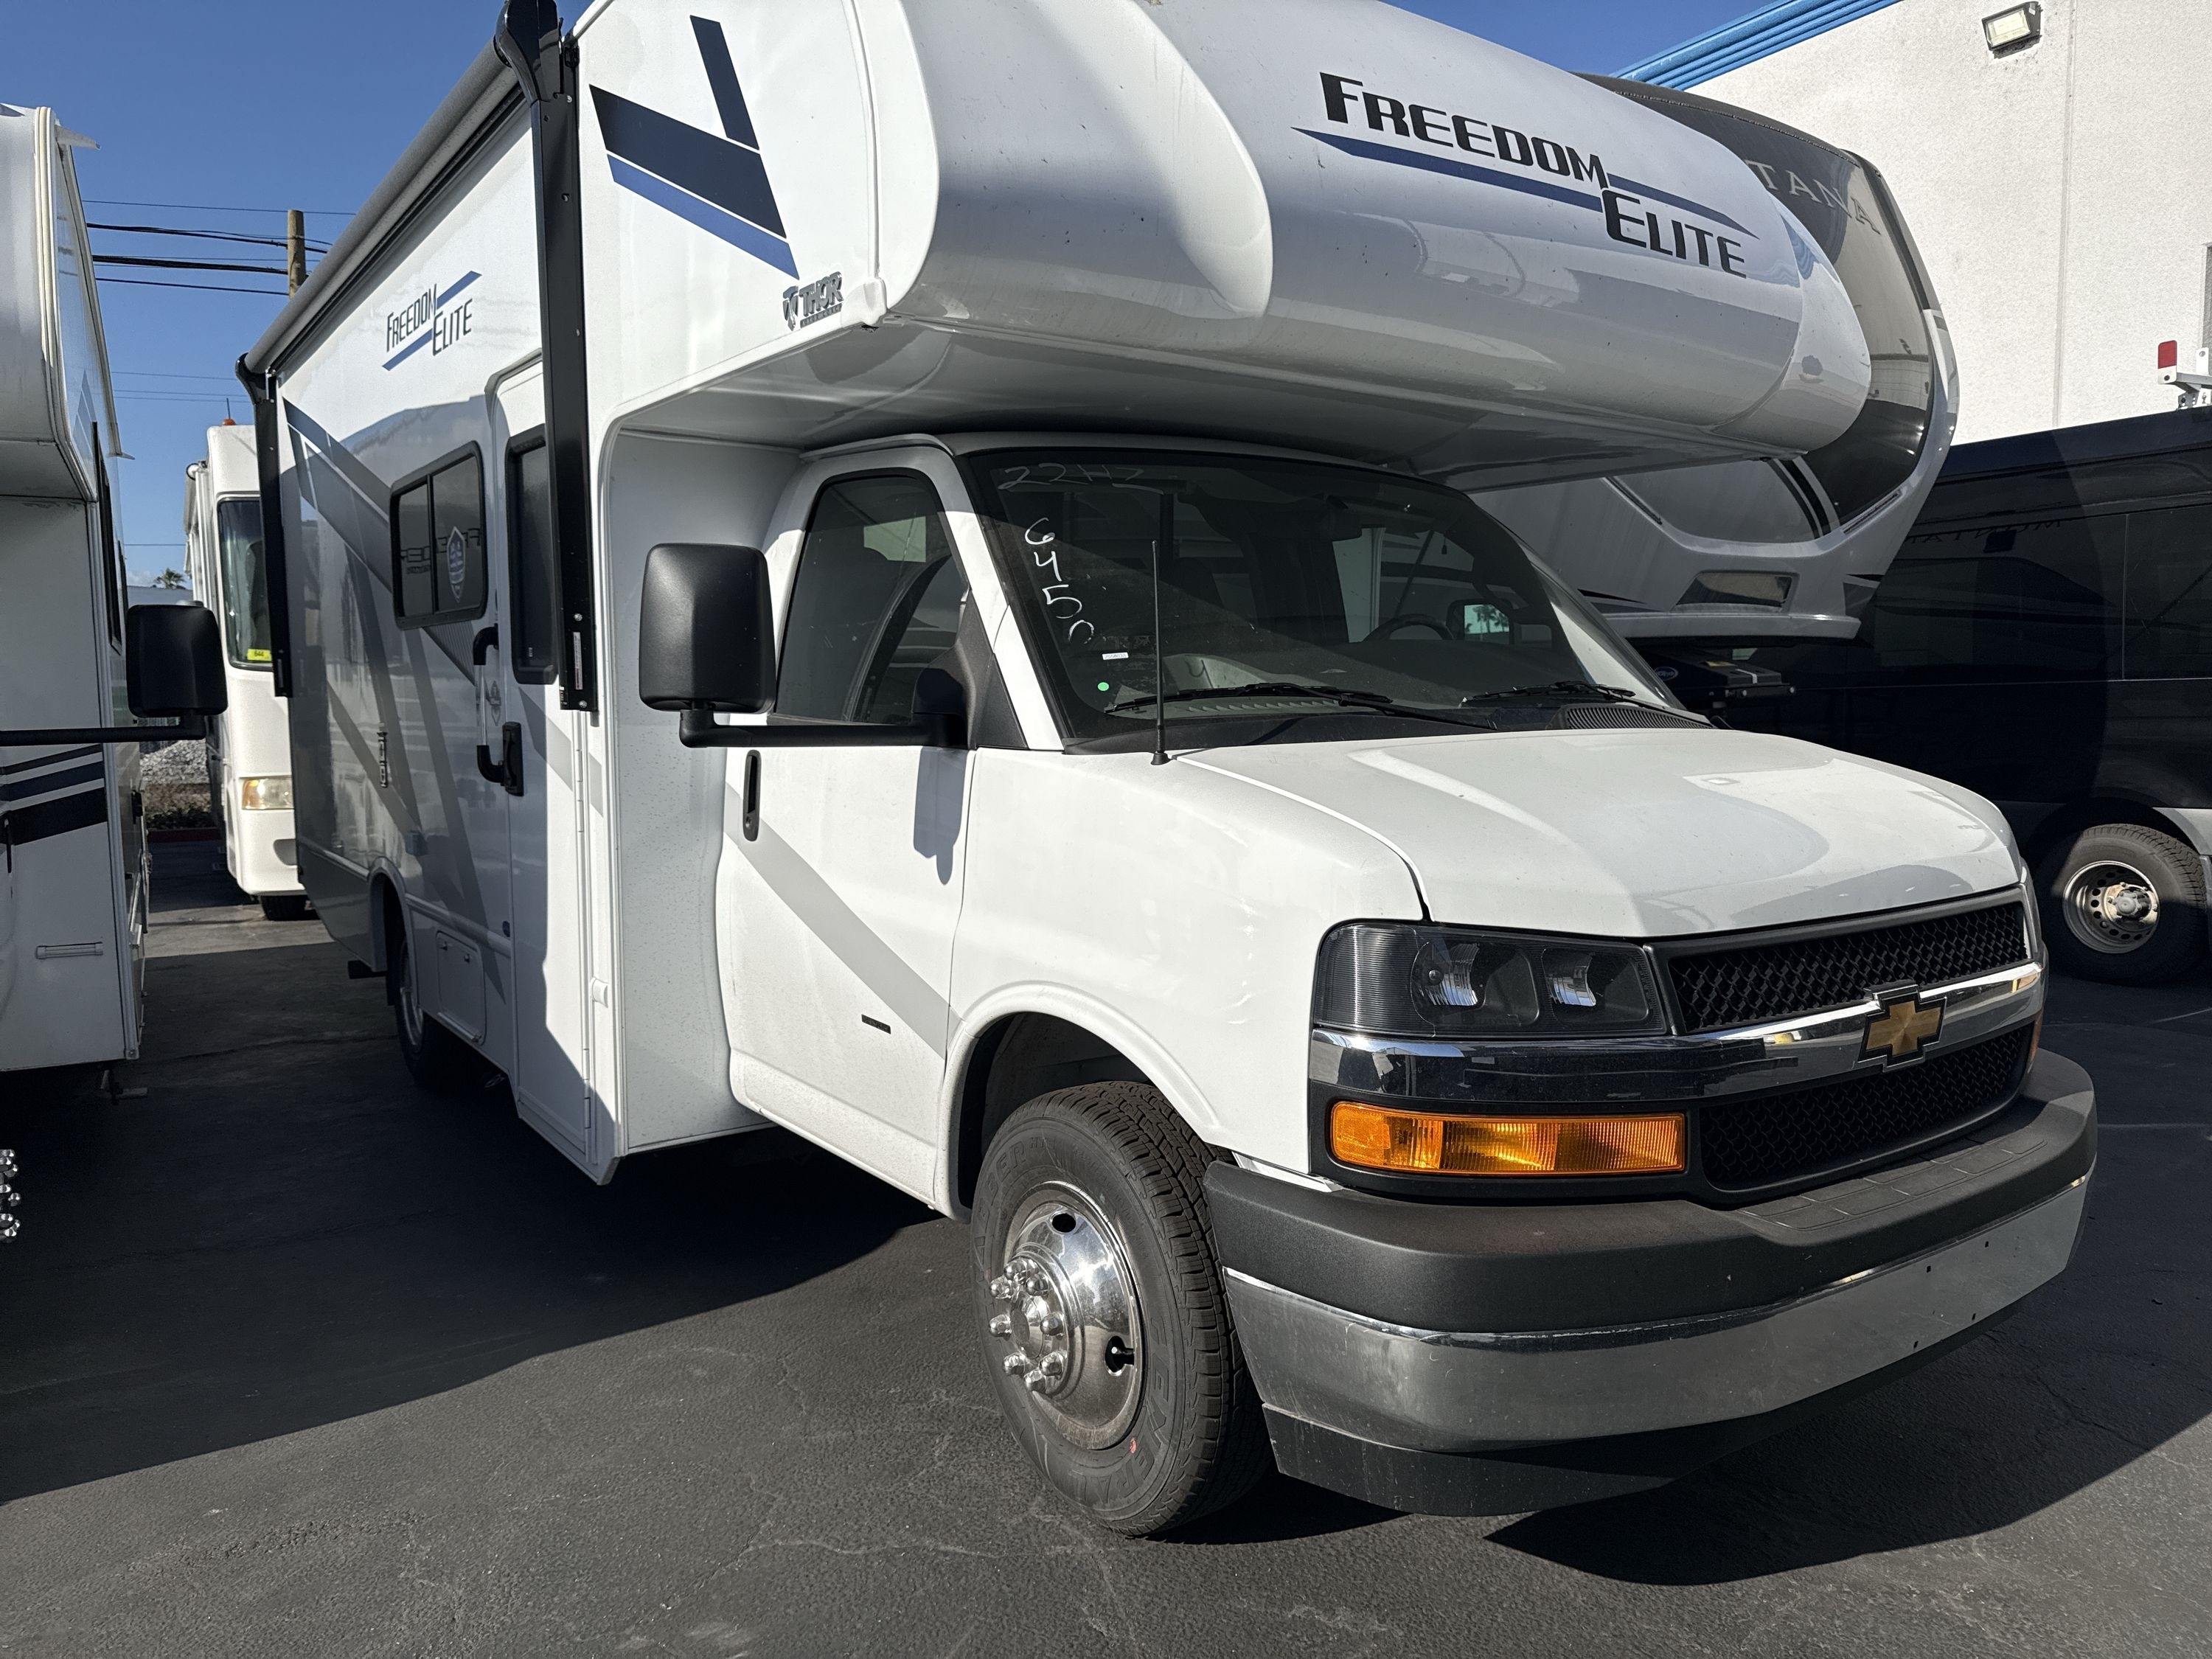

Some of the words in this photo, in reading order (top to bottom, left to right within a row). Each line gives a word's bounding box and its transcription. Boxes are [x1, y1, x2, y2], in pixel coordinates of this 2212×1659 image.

[1320, 72, 1610, 188] FREEDOM
[1601, 187, 1747, 279] ELITE
[386, 283, 437, 352] FREEDOM
[433, 298, 473, 357] ELITE
[799, 271, 844, 317] THOR
